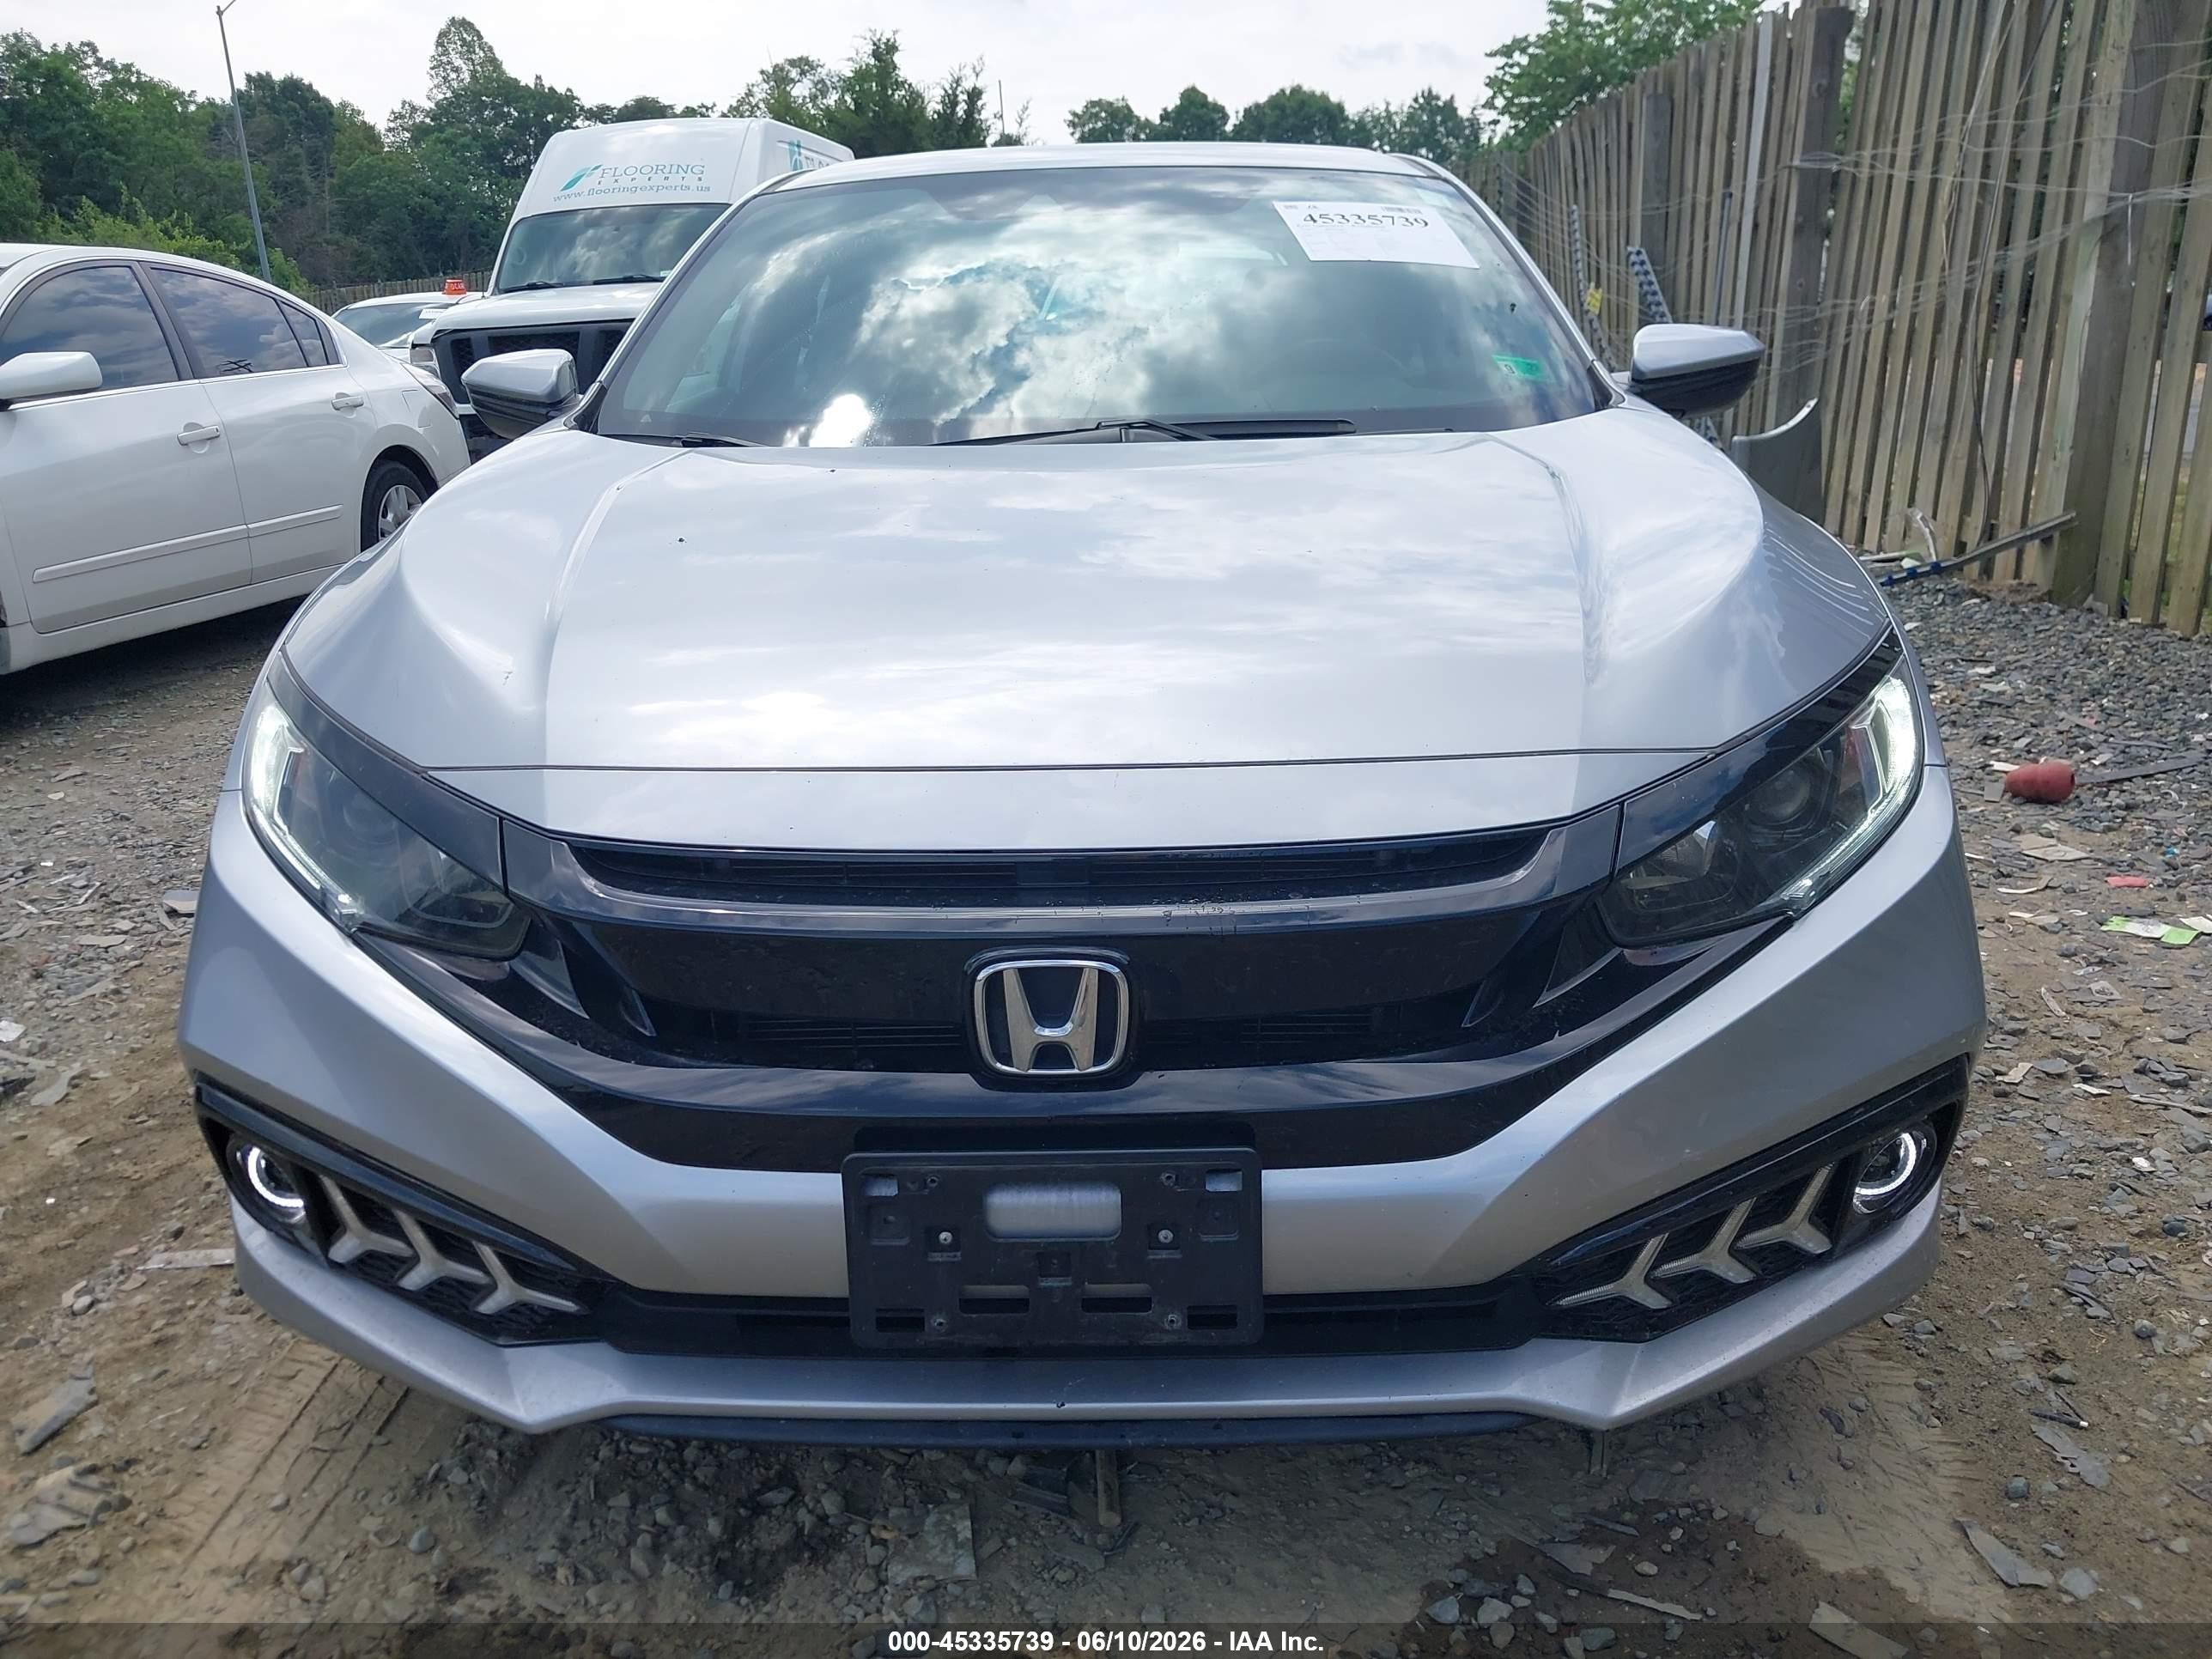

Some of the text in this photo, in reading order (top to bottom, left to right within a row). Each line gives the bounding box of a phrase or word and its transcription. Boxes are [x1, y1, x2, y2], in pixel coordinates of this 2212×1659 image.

[601, 164, 705, 179] FLOORING
[553, 184, 711, 202] www.flooringexperts.us
[1304, 214, 1428, 228] 45335739
